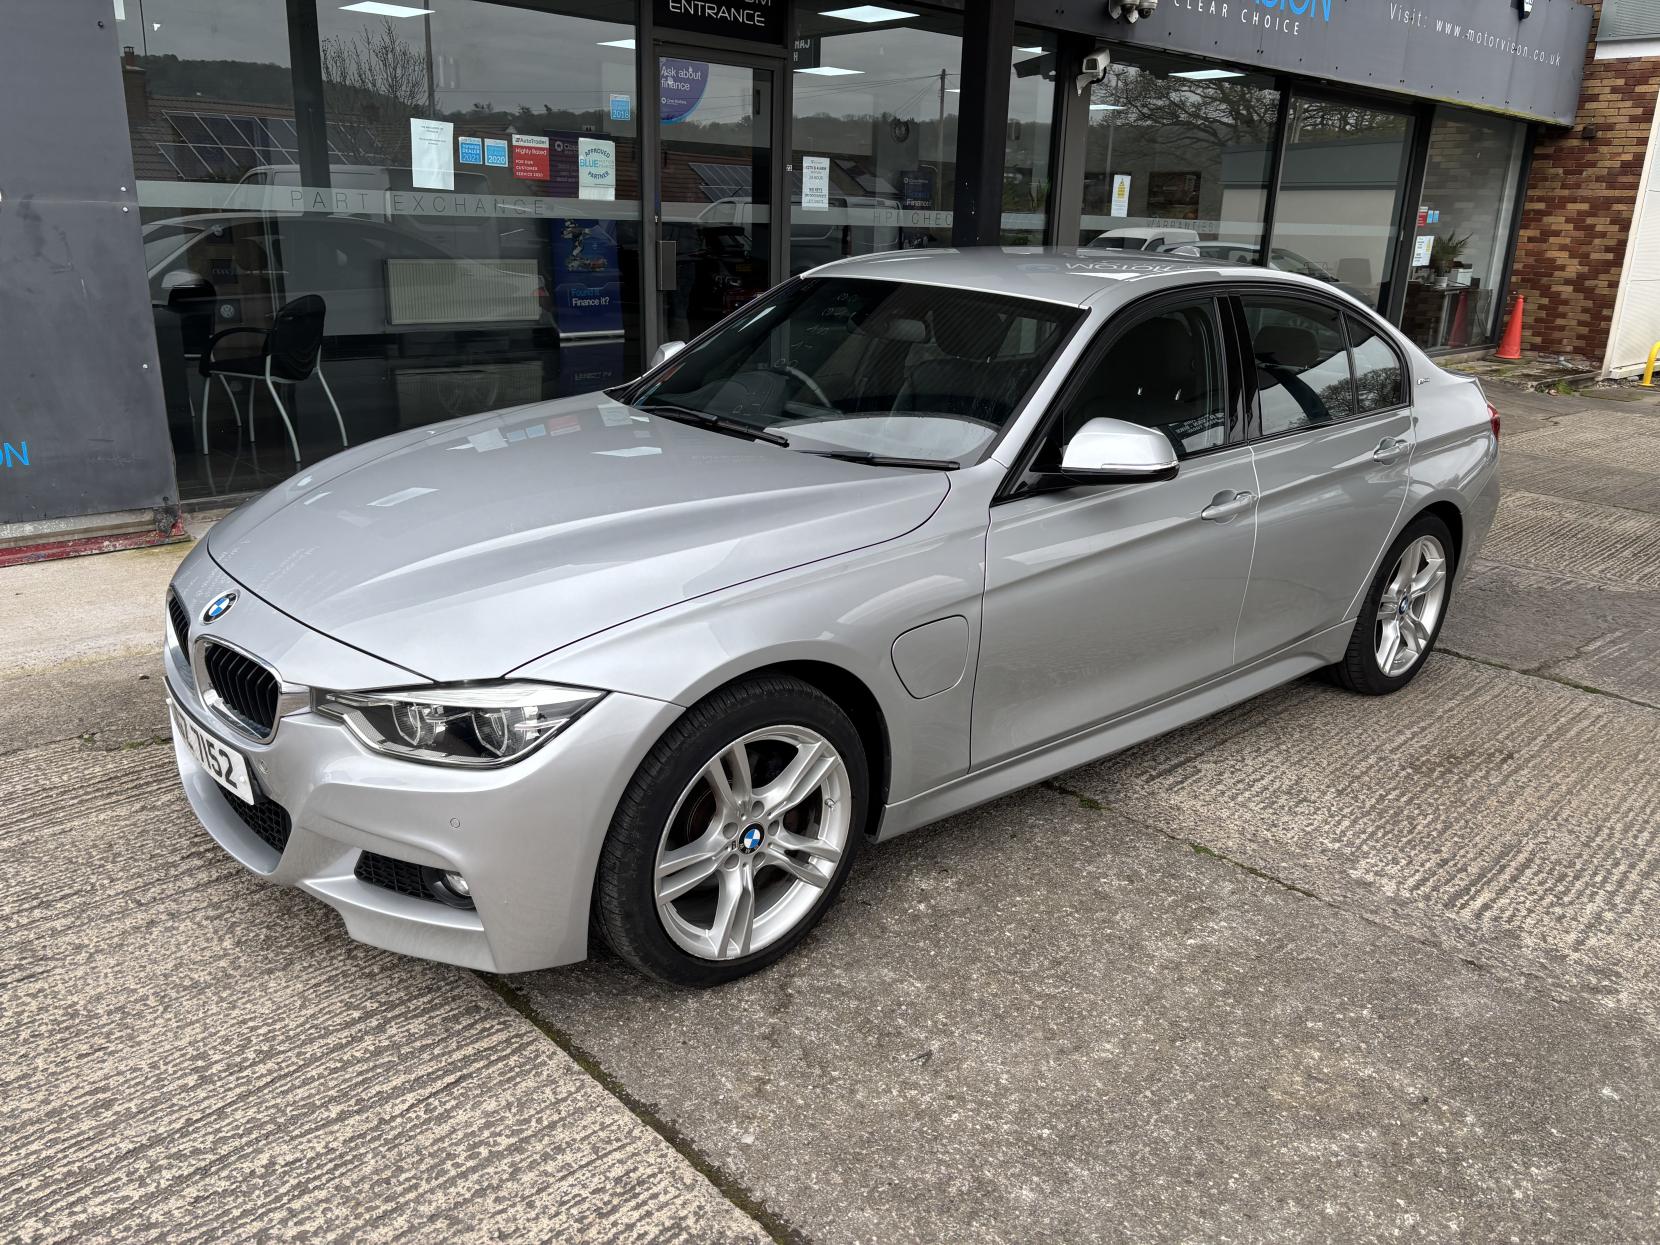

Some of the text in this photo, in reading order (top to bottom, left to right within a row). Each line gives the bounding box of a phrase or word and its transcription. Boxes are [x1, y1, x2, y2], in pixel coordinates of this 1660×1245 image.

[669, 0, 766, 26] ENTRANCE
[1173, 0, 1300, 35] CLEAR CHOICE
[1389, 2, 1428, 28] Visit:
[660, 66, 701, 80] Ask about
[660, 78, 691, 91] finance
[515, 148, 531, 156] Highly
[584, 147, 611, 159] APPROVED
[488, 155, 506, 164] 2020
[580, 158, 599, 168] BLUE
[587, 170, 610, 180] PARTNER
[290, 190, 545, 216] PART EXCHANGE
[873, 211, 900, 225] HPI
[572, 296, 610, 307] Finance it?
[0, 440, 30, 468] N
